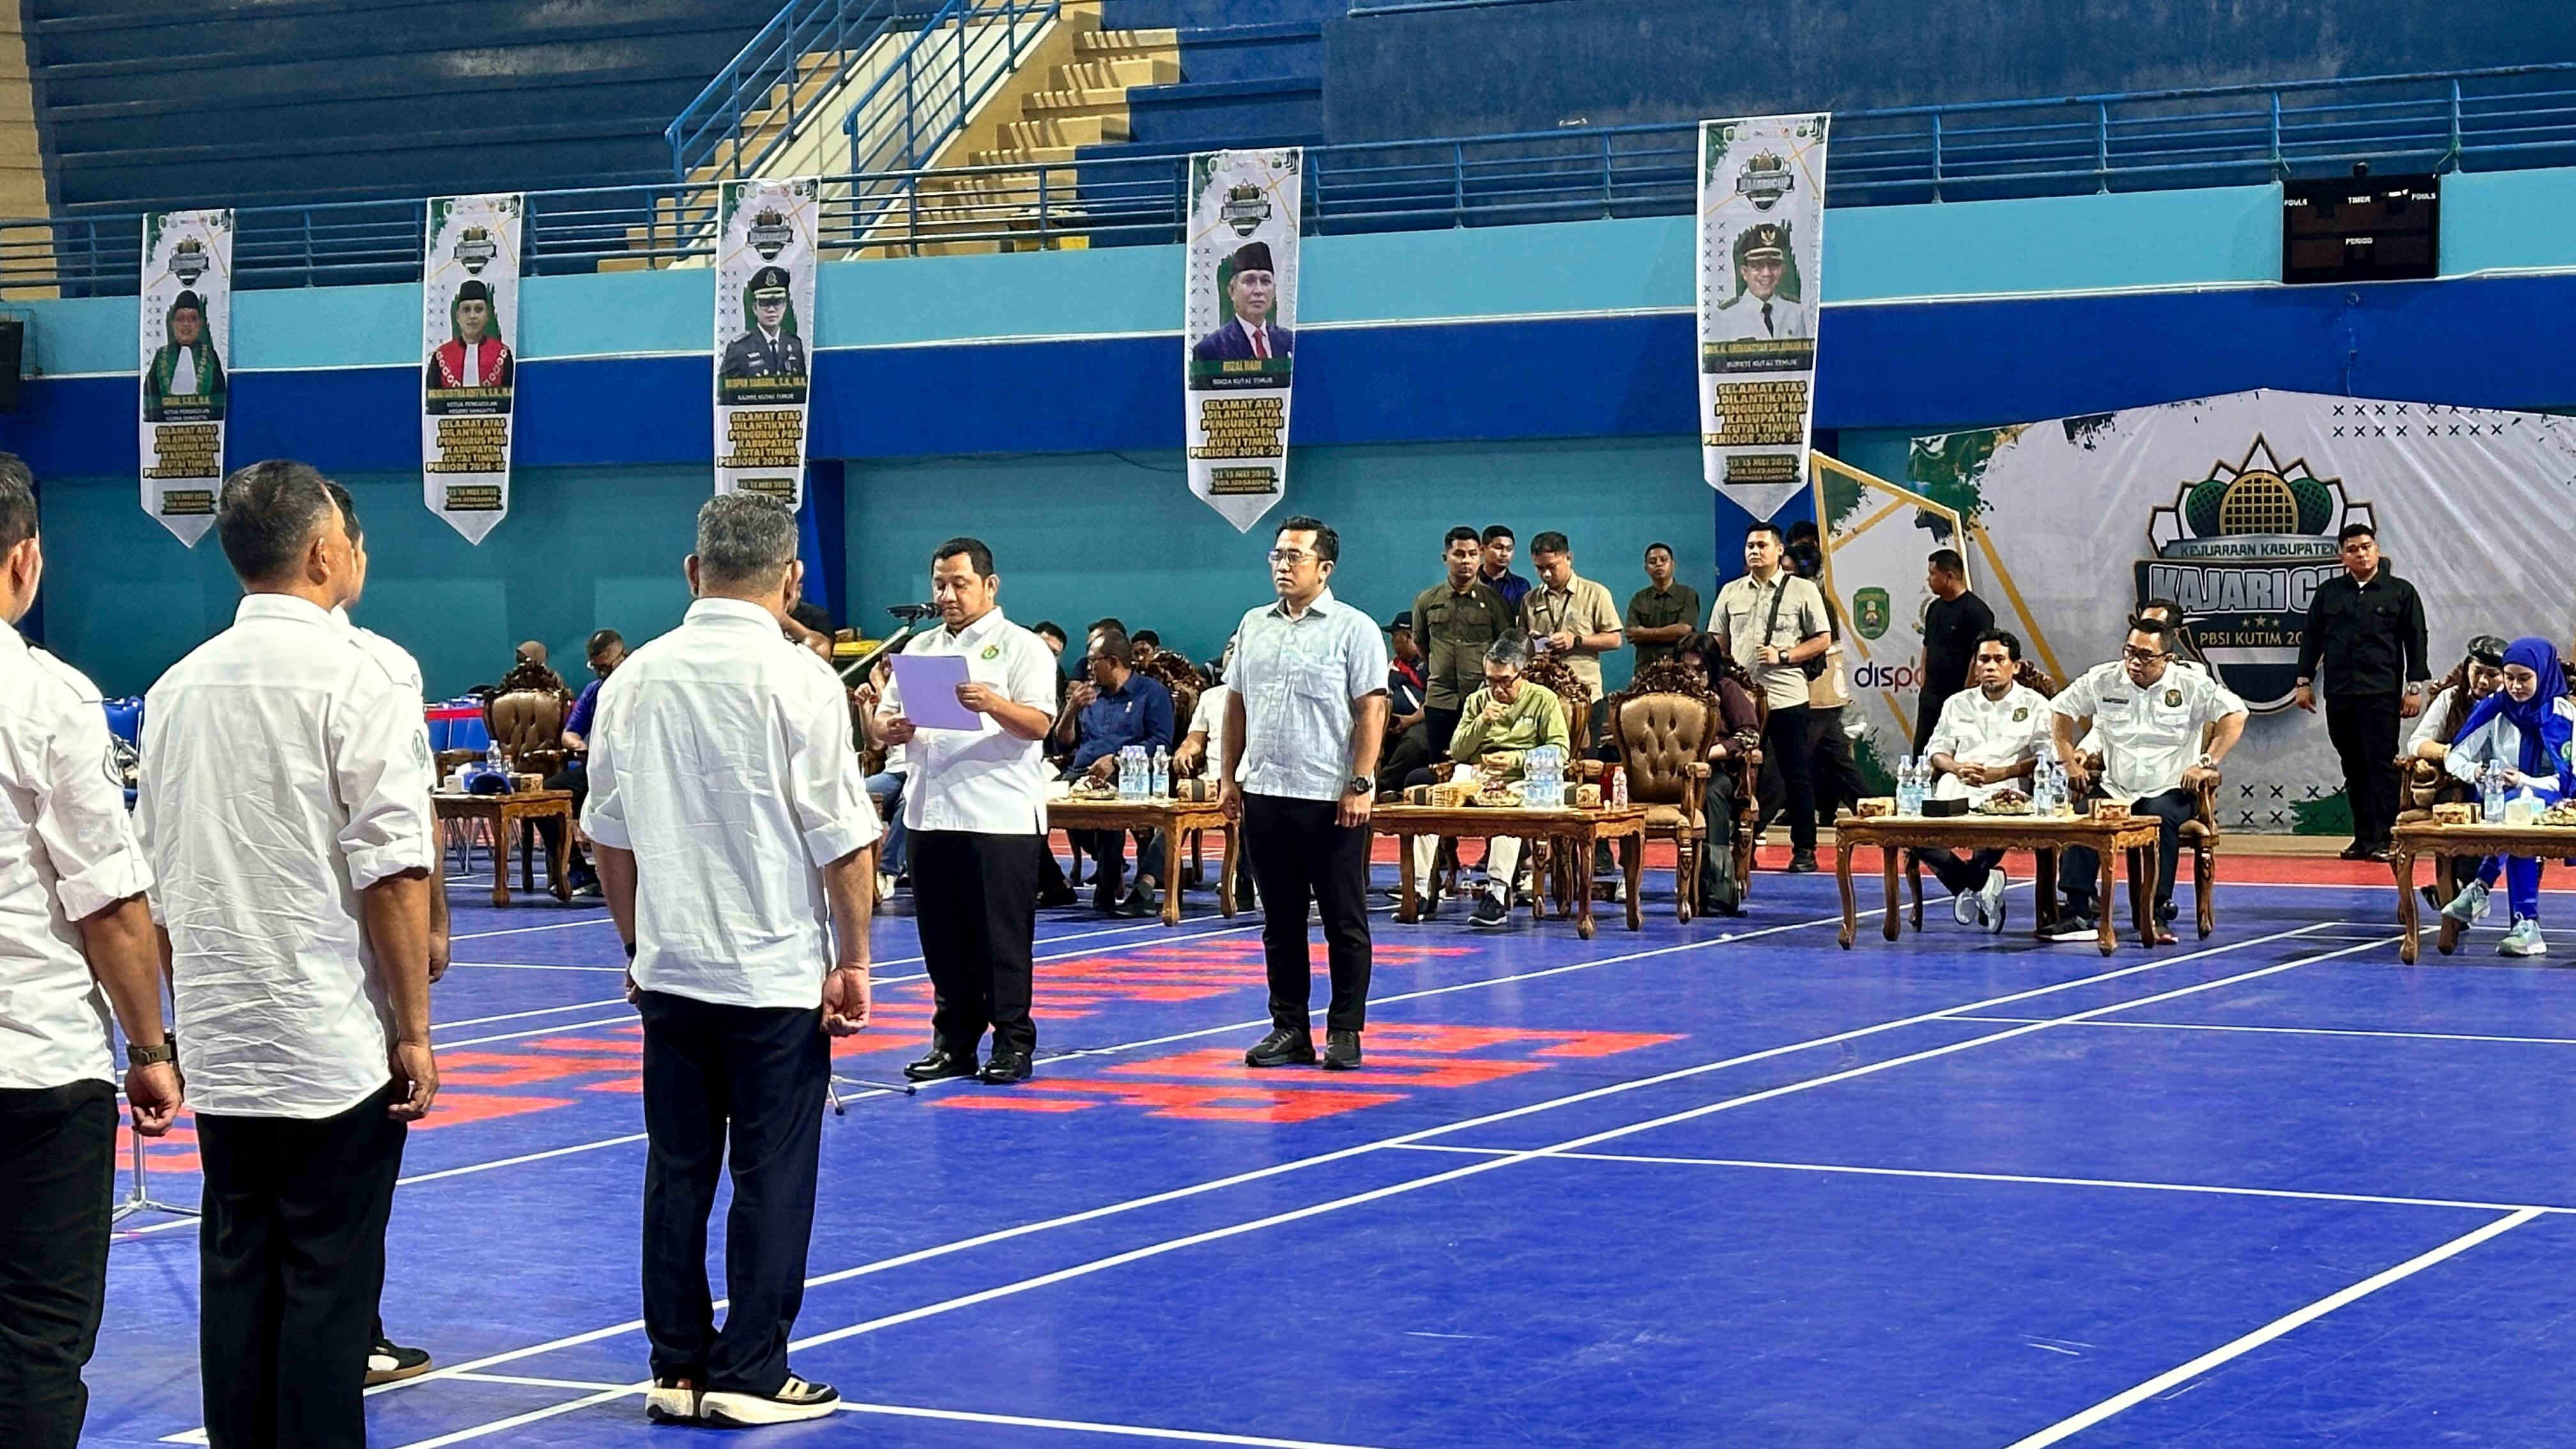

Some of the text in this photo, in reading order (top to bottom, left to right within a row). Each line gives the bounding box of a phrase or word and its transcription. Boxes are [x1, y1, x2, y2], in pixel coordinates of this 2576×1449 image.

[2348, 196, 2371, 204] TIMER
[1719, 382, 1805, 394] SELAMAT ATAS
[1721, 393, 1803, 404] DILANTIKNYA
[1204, 399, 1282, 410] SELAMAT ATAS
[1716, 402, 1807, 415] PENGURUS PBSI
[731, 411, 801, 422] SELAMAT ATAS
[1206, 409, 1278, 419] DILANTIKNYA
[1726, 413, 1797, 424] KABUPATEN
[440, 418, 505, 429] SELAMAT ATAS
[733, 420, 798, 431] DILANTIKNYA
[1202, 418, 1283, 429] PENGURUS PBSI
[1724, 422, 1800, 434] KUTAI TIMUR
[442, 427, 503, 437] DILANTIKNYA
[730, 429, 802, 440] PENGURUS PBSI
[1211, 428, 1275, 438] KABUPATEN
[438, 437, 486, 446] PENGURUS
[737, 439, 795, 448] KABUPATEN
[1209, 436, 1276, 447] KUTAI TIMUR
[1704, 434, 1755, 445] PERIODE
[445, 445, 500, 454] KABUPATEN
[735, 447, 797, 457] KUTAI TIMUR
[1190, 447, 1237, 457] PERIODE
[444, 453, 502, 463] KUTAI TIMUR
[718, 457, 760, 466] PERIODE
[1771, 457, 1793, 466] 2025
[427, 463, 468, 471] PERIODE
[2181, 542, 2339, 557] KEJUARAAN KABUPATEN
[2150, 564, 2288, 614] KAJARI
[2200, 632, 2230, 645] PBSI
[2236, 631, 2281, 645] KUTIM
